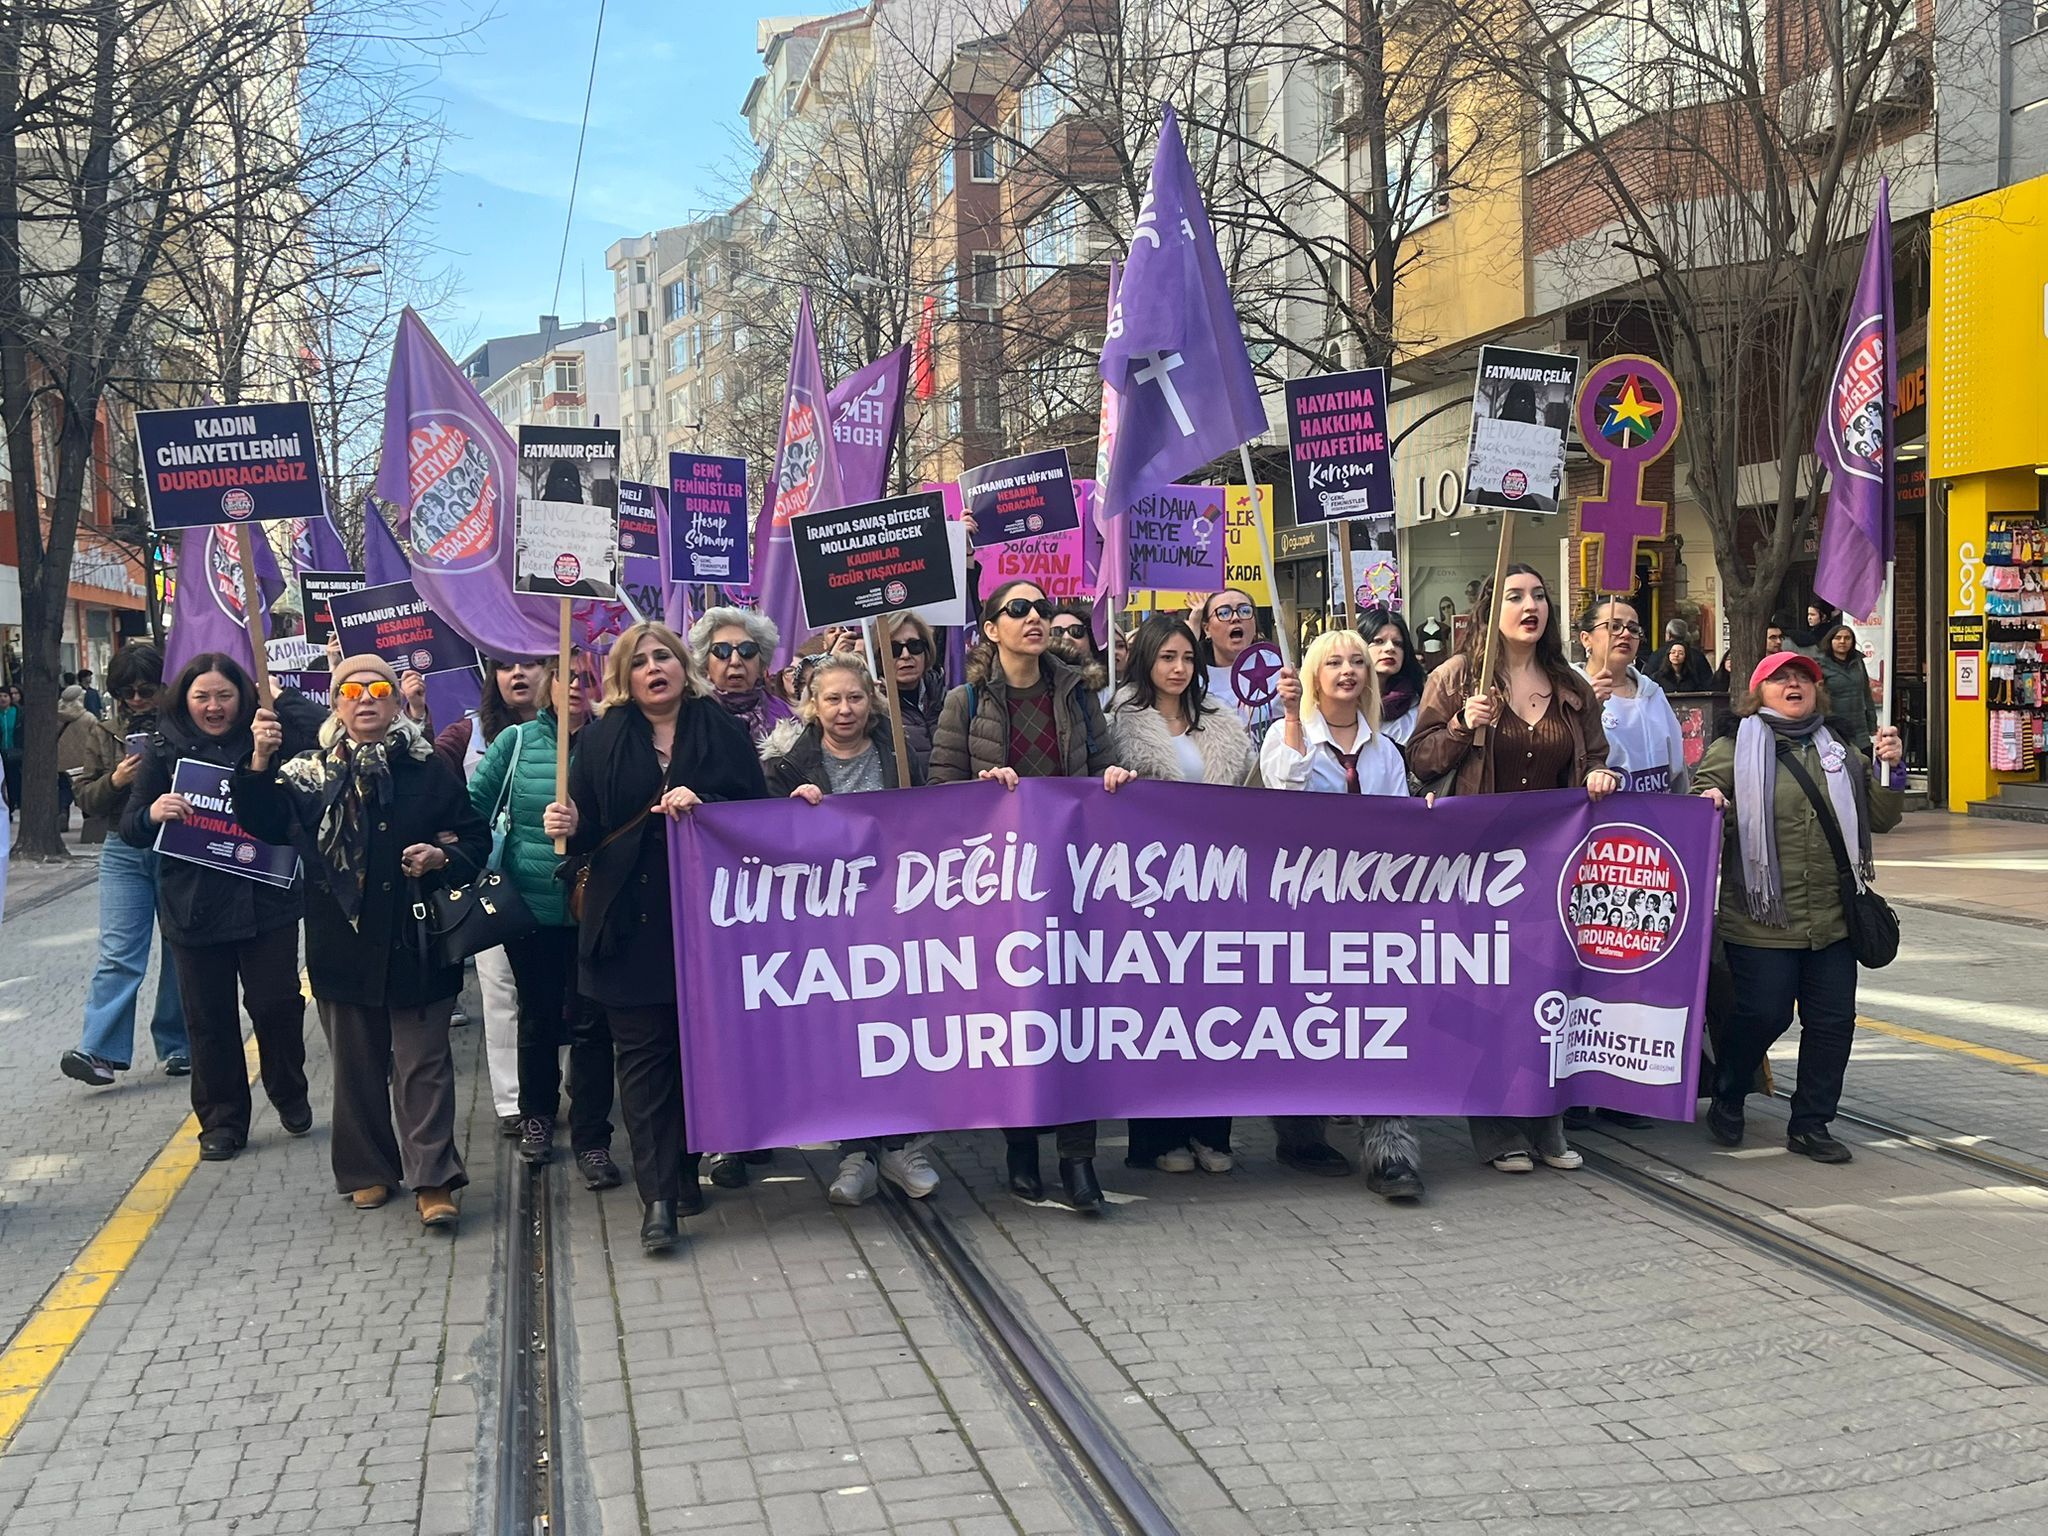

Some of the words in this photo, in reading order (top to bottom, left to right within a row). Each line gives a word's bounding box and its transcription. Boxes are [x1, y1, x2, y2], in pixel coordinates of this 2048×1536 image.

[1485, 365, 1543, 381] FATMANUR
[1543, 367, 1573, 386] ÇELİK
[1296, 388, 1374, 415] HAYATIMA
[194, 415, 256, 438] KADIN
[1300, 411, 1374, 438] HAKKIMA
[157, 432, 301, 467] CİNAYETLERİNİ
[523, 444, 584, 459] FATMANUR
[585, 441, 616, 462] ÇELİK
[1295, 431, 1384, 461] KIYAFETİME
[158, 458, 308, 492] DURDURACAĞIZ
[693, 463, 722, 481] GENÇ
[967, 479, 1014, 497] FATMANUR
[1014, 475, 1027, 487] VE
[1028, 467, 1064, 484] HİFA'NIN
[1308, 461, 1373, 489] Karışma
[674, 478, 743, 498] FEMİNİSTLER
[997, 486, 1039, 501] HESABINI
[1416, 469, 1462, 522] LO
[686, 497, 731, 514] BURAYA
[996, 495, 1046, 514] SORACAĞIZ
[1160, 496, 1198, 521] DAHA
[690, 512, 727, 536] Hesap
[806, 521, 852, 541] İRAN'DA
[852, 515, 887, 533] SAVAŞ
[887, 506, 931, 526] BİTECEK
[685, 529, 734, 552] Sormaya
[820, 534, 878, 555] MOLLALAR
[878, 525, 924, 544] GİDECEK
[846, 546, 900, 567] KADINLAR
[828, 568, 865, 588] ÖZGÜR
[865, 558, 926, 583] YAŞAYACAK
[1226, 565, 1262, 581] KADA
[341, 607, 396, 628] FATMANUR
[396, 604, 411, 617] VE
[376, 616, 425, 635] HESABINI
[375, 628, 434, 650] SORACAĞIZ
[184, 792, 224, 812] KADIN
[1586, 841, 1661, 867] KADIN
[709, 855, 878, 928] LÜTUF
[891, 831, 1051, 915] DEĞİL
[1066, 840, 1248, 919] YAŞAM
[1268, 845, 1528, 911] HAKKIMIZ
[740, 935, 979, 1011] KADIN
[994, 916, 1510, 988] CİNAYETLERİNİ
[1568, 1008, 1602, 1027] GENÇ
[856, 991, 1408, 1079] DURDURACAĞIZ
[1567, 1029, 1676, 1059] FEMİNİSTLER
[1564, 1050, 1648, 1072] FEDERASYONU
